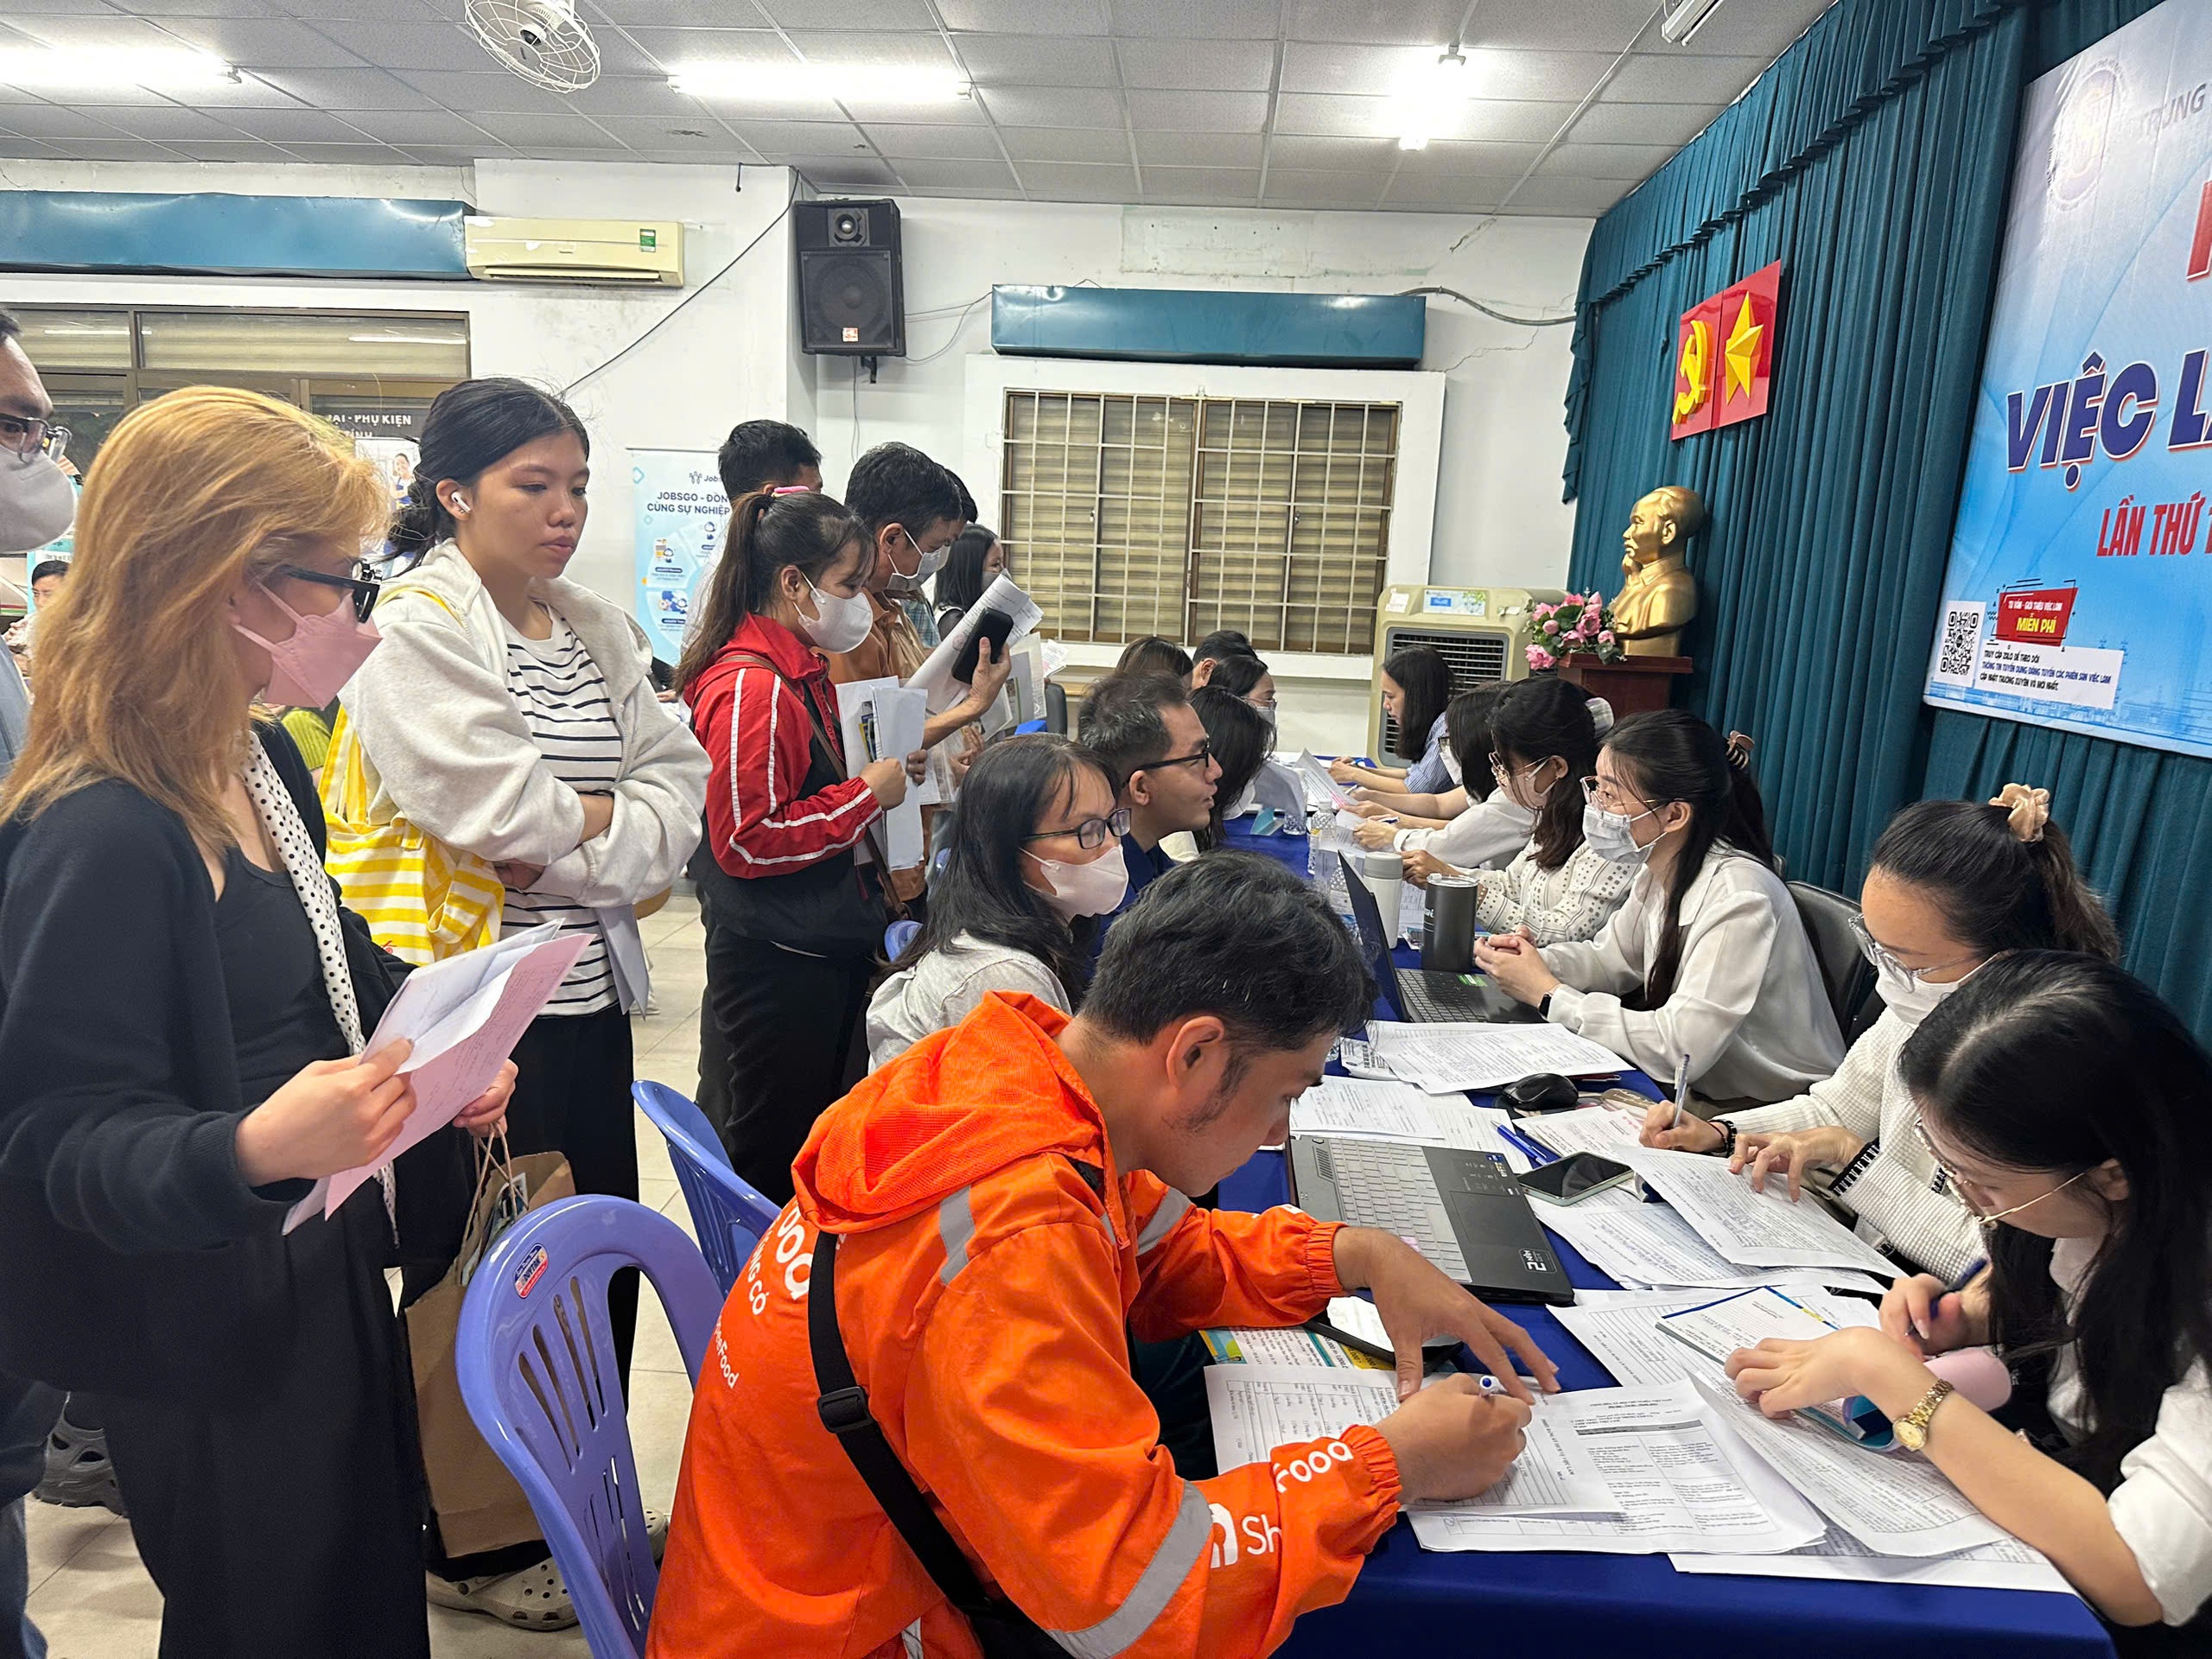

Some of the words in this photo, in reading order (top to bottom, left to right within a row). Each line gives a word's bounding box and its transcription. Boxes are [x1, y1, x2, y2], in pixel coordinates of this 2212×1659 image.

[354, 415, 379, 426] PHỤ
[382, 415, 412, 428] KIỆN
[2007, 349, 2159, 493] VIỆC
[657, 491, 699, 502] JOBSGO
[646, 500, 675, 513] CÙNG
[677, 504, 693, 516] SỰ
[694, 504, 731, 518] NGHIỆP
[2096, 494, 2146, 556] LẦN
[2149, 490, 2209, 556] THỨ
[2016, 613, 2040, 632] MIỄN
[2040, 616, 2057, 633] PHÍ
